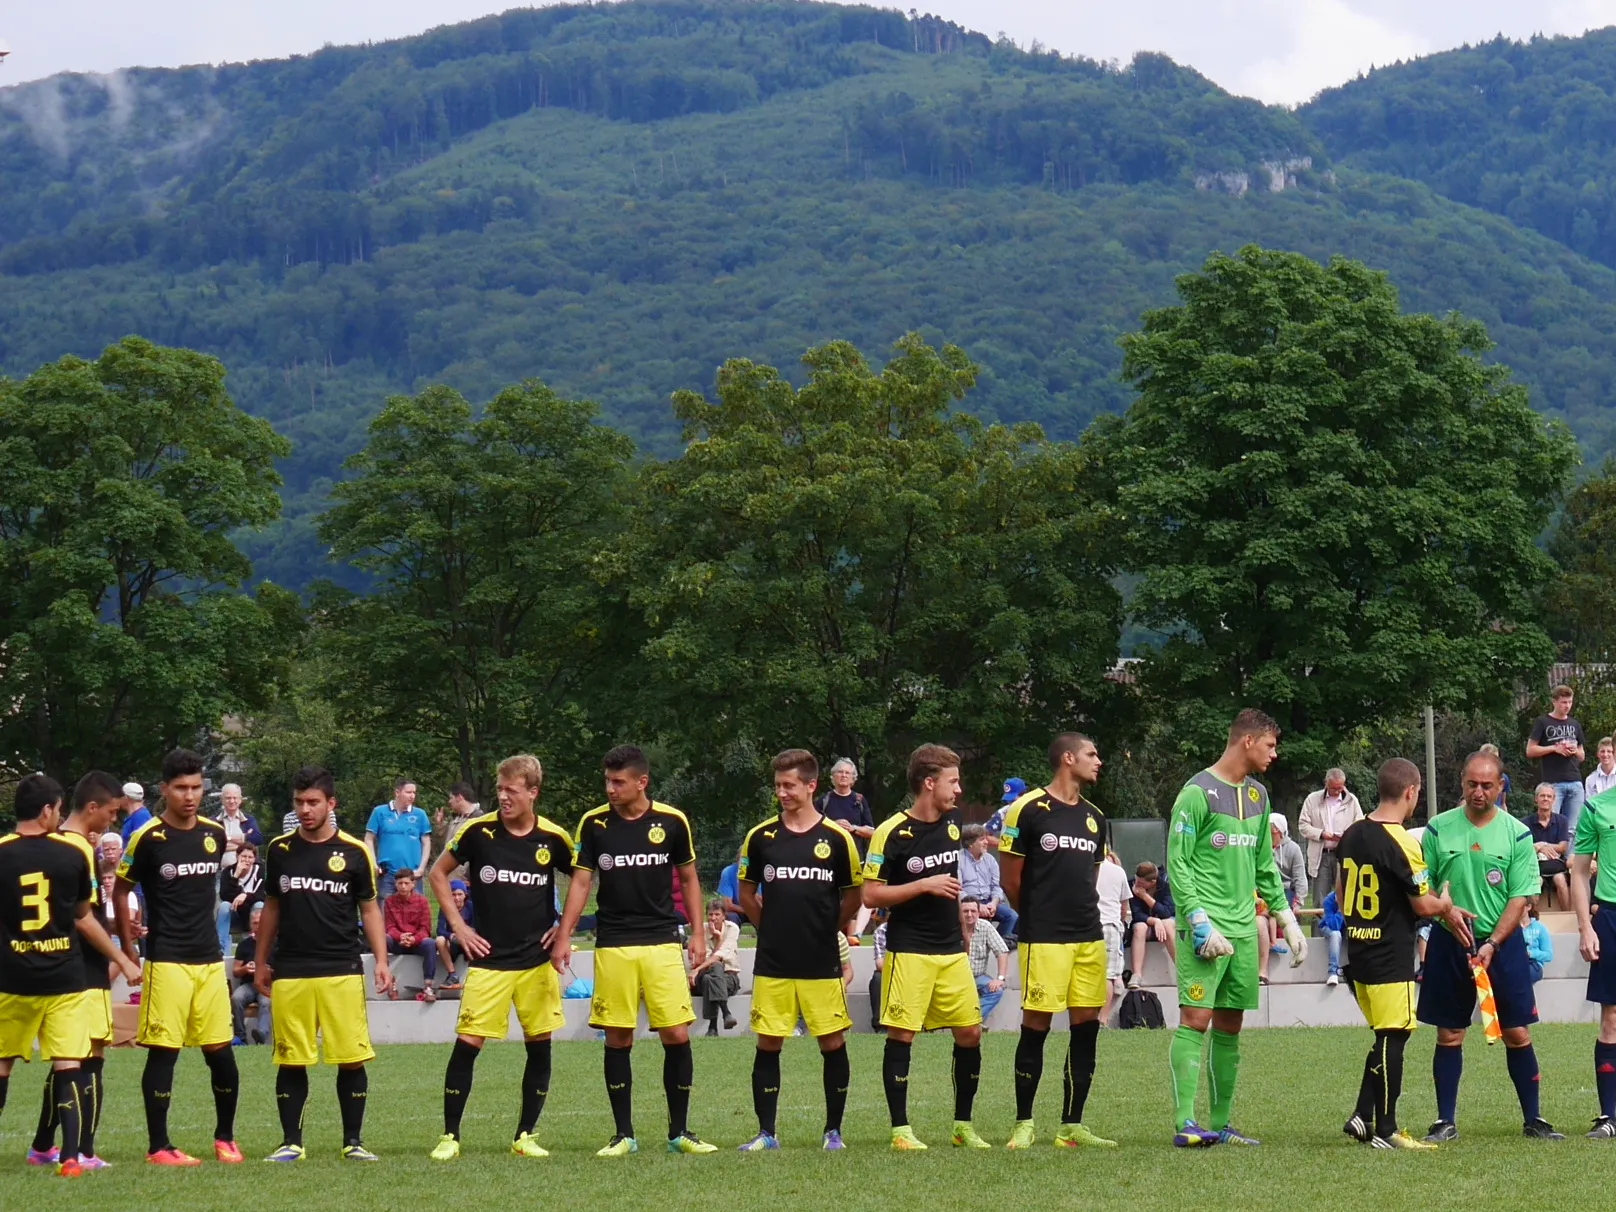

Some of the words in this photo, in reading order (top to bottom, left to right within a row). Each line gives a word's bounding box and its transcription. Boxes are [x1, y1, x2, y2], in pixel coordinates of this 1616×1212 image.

[615, 853, 669, 867] EVONIK
[776, 866, 833, 882] EVONIK
[290, 877, 349, 894] EVONIK
[20, 872, 50, 931] 3
[11, 937, 70, 953] DORTMUND
